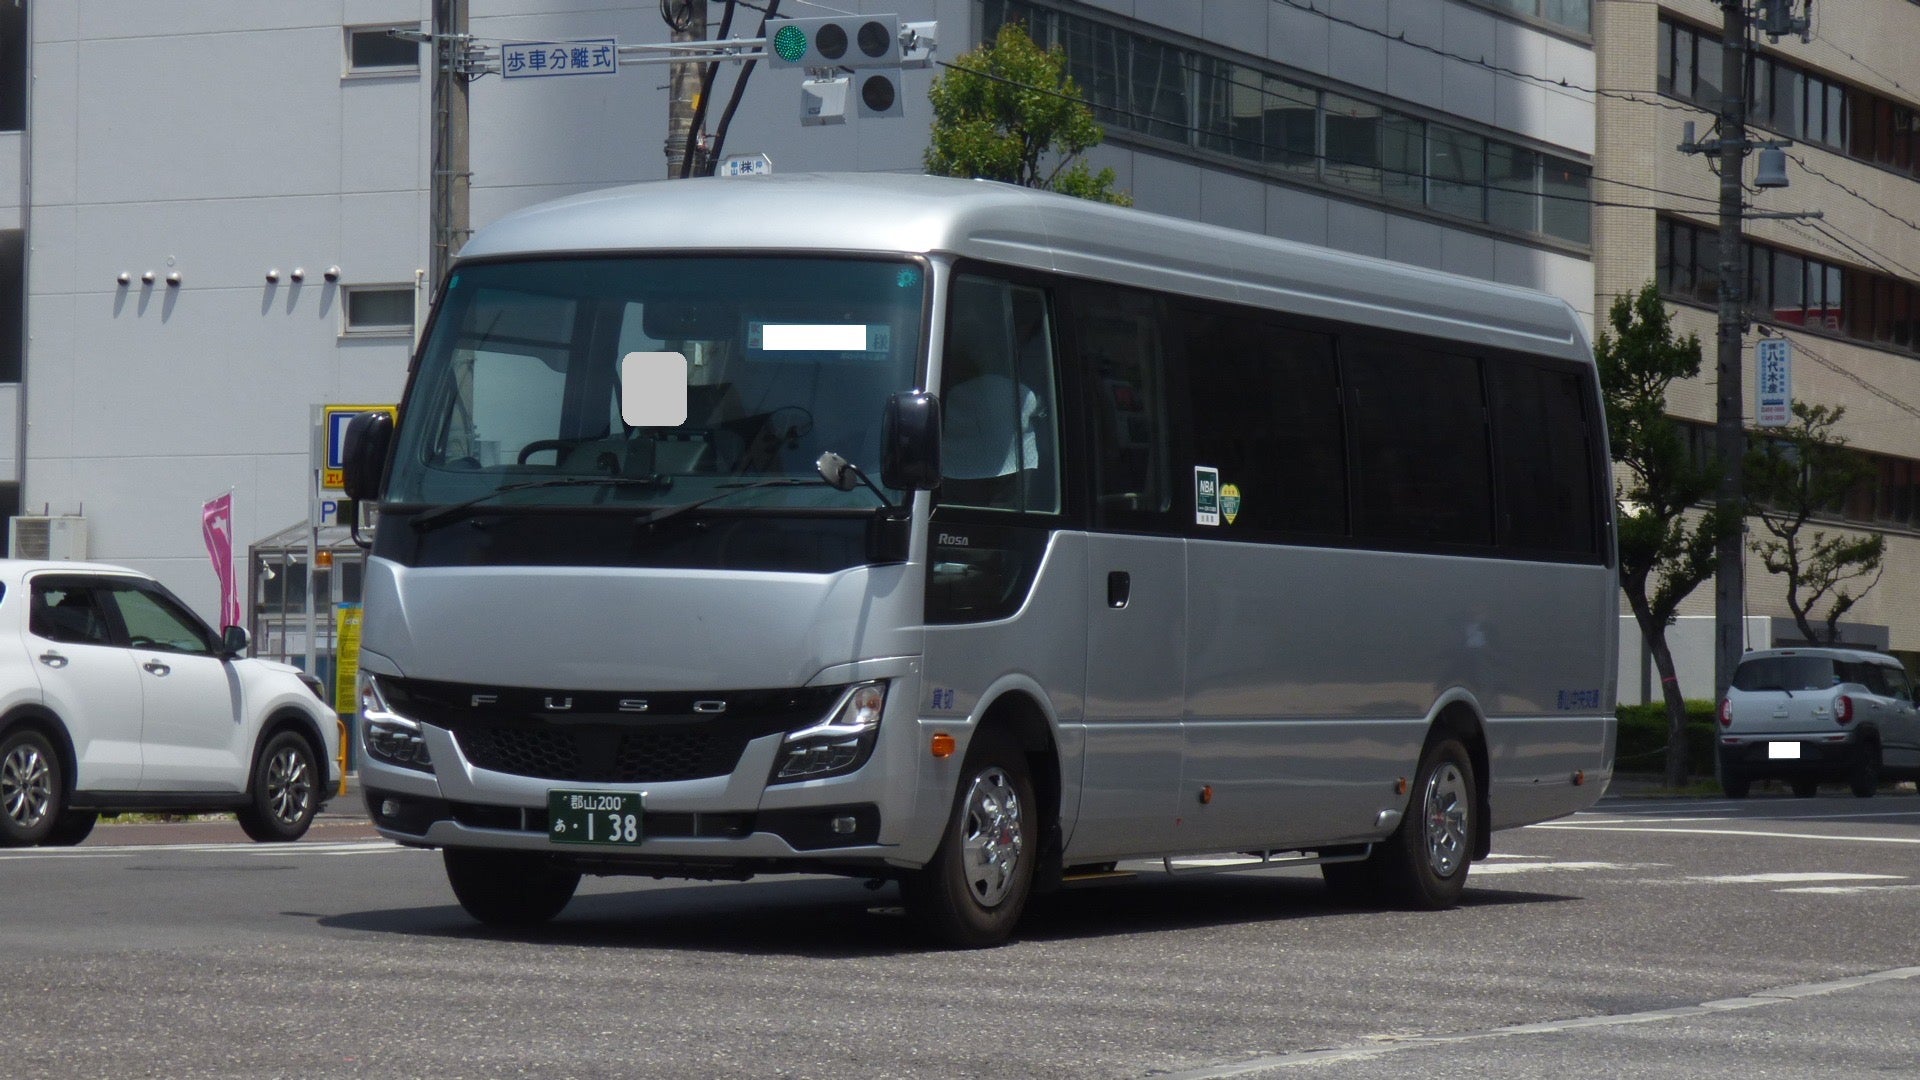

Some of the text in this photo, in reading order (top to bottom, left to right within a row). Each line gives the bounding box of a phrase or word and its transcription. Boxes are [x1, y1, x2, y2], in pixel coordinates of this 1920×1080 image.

[507, 45, 611, 72] 歩車分離式
[1200, 480, 1215, 493] NBA
[321, 501, 337, 524] P
[471, 694, 727, 714] FUSO
